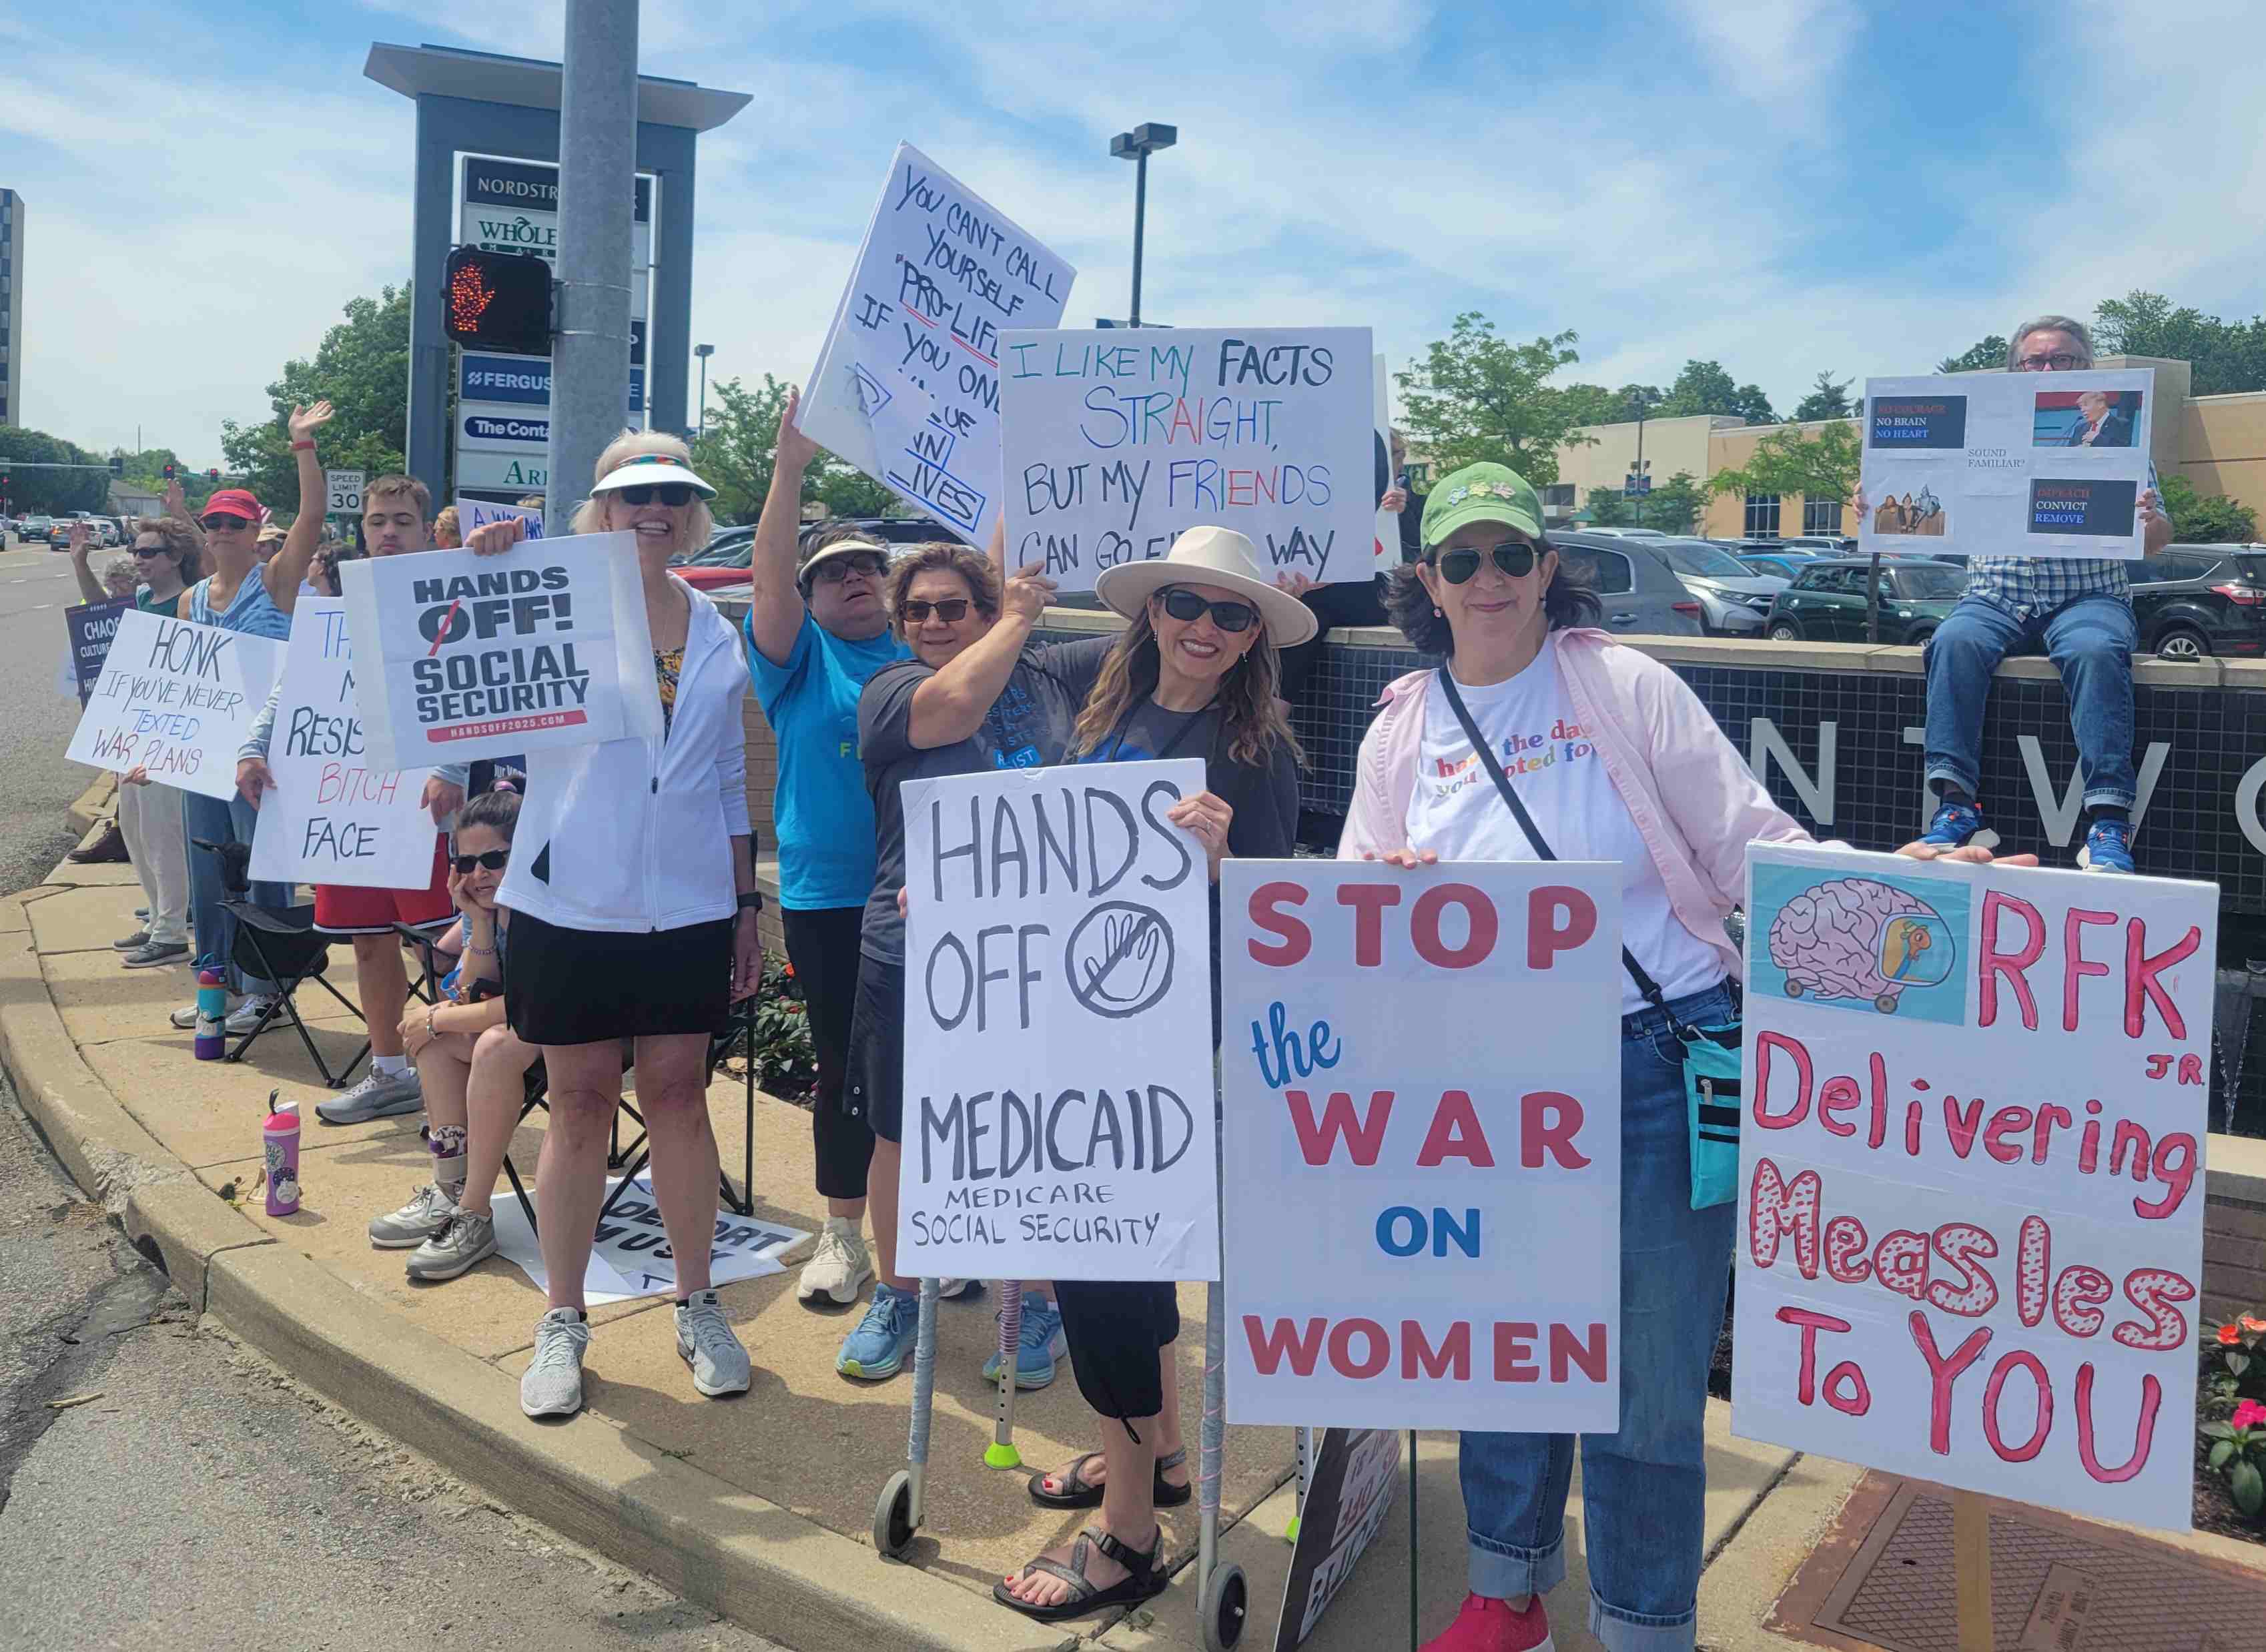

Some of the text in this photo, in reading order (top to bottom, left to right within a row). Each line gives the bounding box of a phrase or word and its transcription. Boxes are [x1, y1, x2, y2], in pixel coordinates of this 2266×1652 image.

[478, 177, 558, 199] NORDSTR
[895, 165, 1059, 304] YOU CAN'T CALL
[923, 223, 1024, 316] YOURSELF
[856, 294, 893, 330] IF
[902, 322, 950, 372] YOU
[484, 372, 551, 390] FERGUS
[1009, 339, 1333, 398] I LIKE MY FACTS
[475, 420, 506, 435] The
[1875, 429, 1929, 438] NO HEART
[1876, 417, 1927, 426] NO BRAIN
[1968, 448, 2007, 457] SOUND
[331, 474, 361, 482] SPEED
[332, 493, 359, 508] 30
[1024, 458, 1331, 531] BUT MY FRIENDS
[2034, 513, 2085, 524] REMOVE
[2036, 500, 2088, 511] CONVICT
[1019, 531, 1079, 574] CAN
[1095, 530, 1132, 570] GO
[1266, 526, 1335, 582] WAY
[412, 566, 570, 604] HANDS
[418, 593, 573, 646] OFF!
[149, 620, 233, 682] HONK
[412, 642, 589, 695] SOCIAL
[99, 670, 131, 699] IF
[123, 675, 181, 713] YOU'VE
[180, 682, 244, 721] NEVER
[416, 677, 590, 723] SECURITY
[92, 725, 203, 775] WAR PLANS
[130, 709, 200, 741] TEXTED
[286, 706, 364, 756] RESIS
[450, 715, 565, 737] HANDSOFF2025.COM
[1503, 734, 1543, 756] the
[318, 763, 400, 805] BITCH
[1503, 745, 1556, 779] oted
[302, 817, 380, 862] FACE
[932, 780, 1192, 901] HANDS
[1248, 881, 1598, 970] STOP
[925, 923, 1050, 1032] OFF
[1978, 889, 2201, 1041] RFK
[1250, 1000, 1341, 1090] the
[921, 1084, 1194, 1184] MEDICAID
[1285, 1090, 1592, 1170] WAR
[1753, 1030, 2198, 1220] Delivering
[944, 1182, 1115, 1209] MEDICARE
[912, 1210, 1161, 1247] SOCIAL SECURITY
[1375, 1205, 1481, 1258] ON
[1750, 1157, 2195, 1352] Measles
[1242, 1314, 1608, 1384] WOMEN
[1776, 1306, 2161, 1484] To YOU
